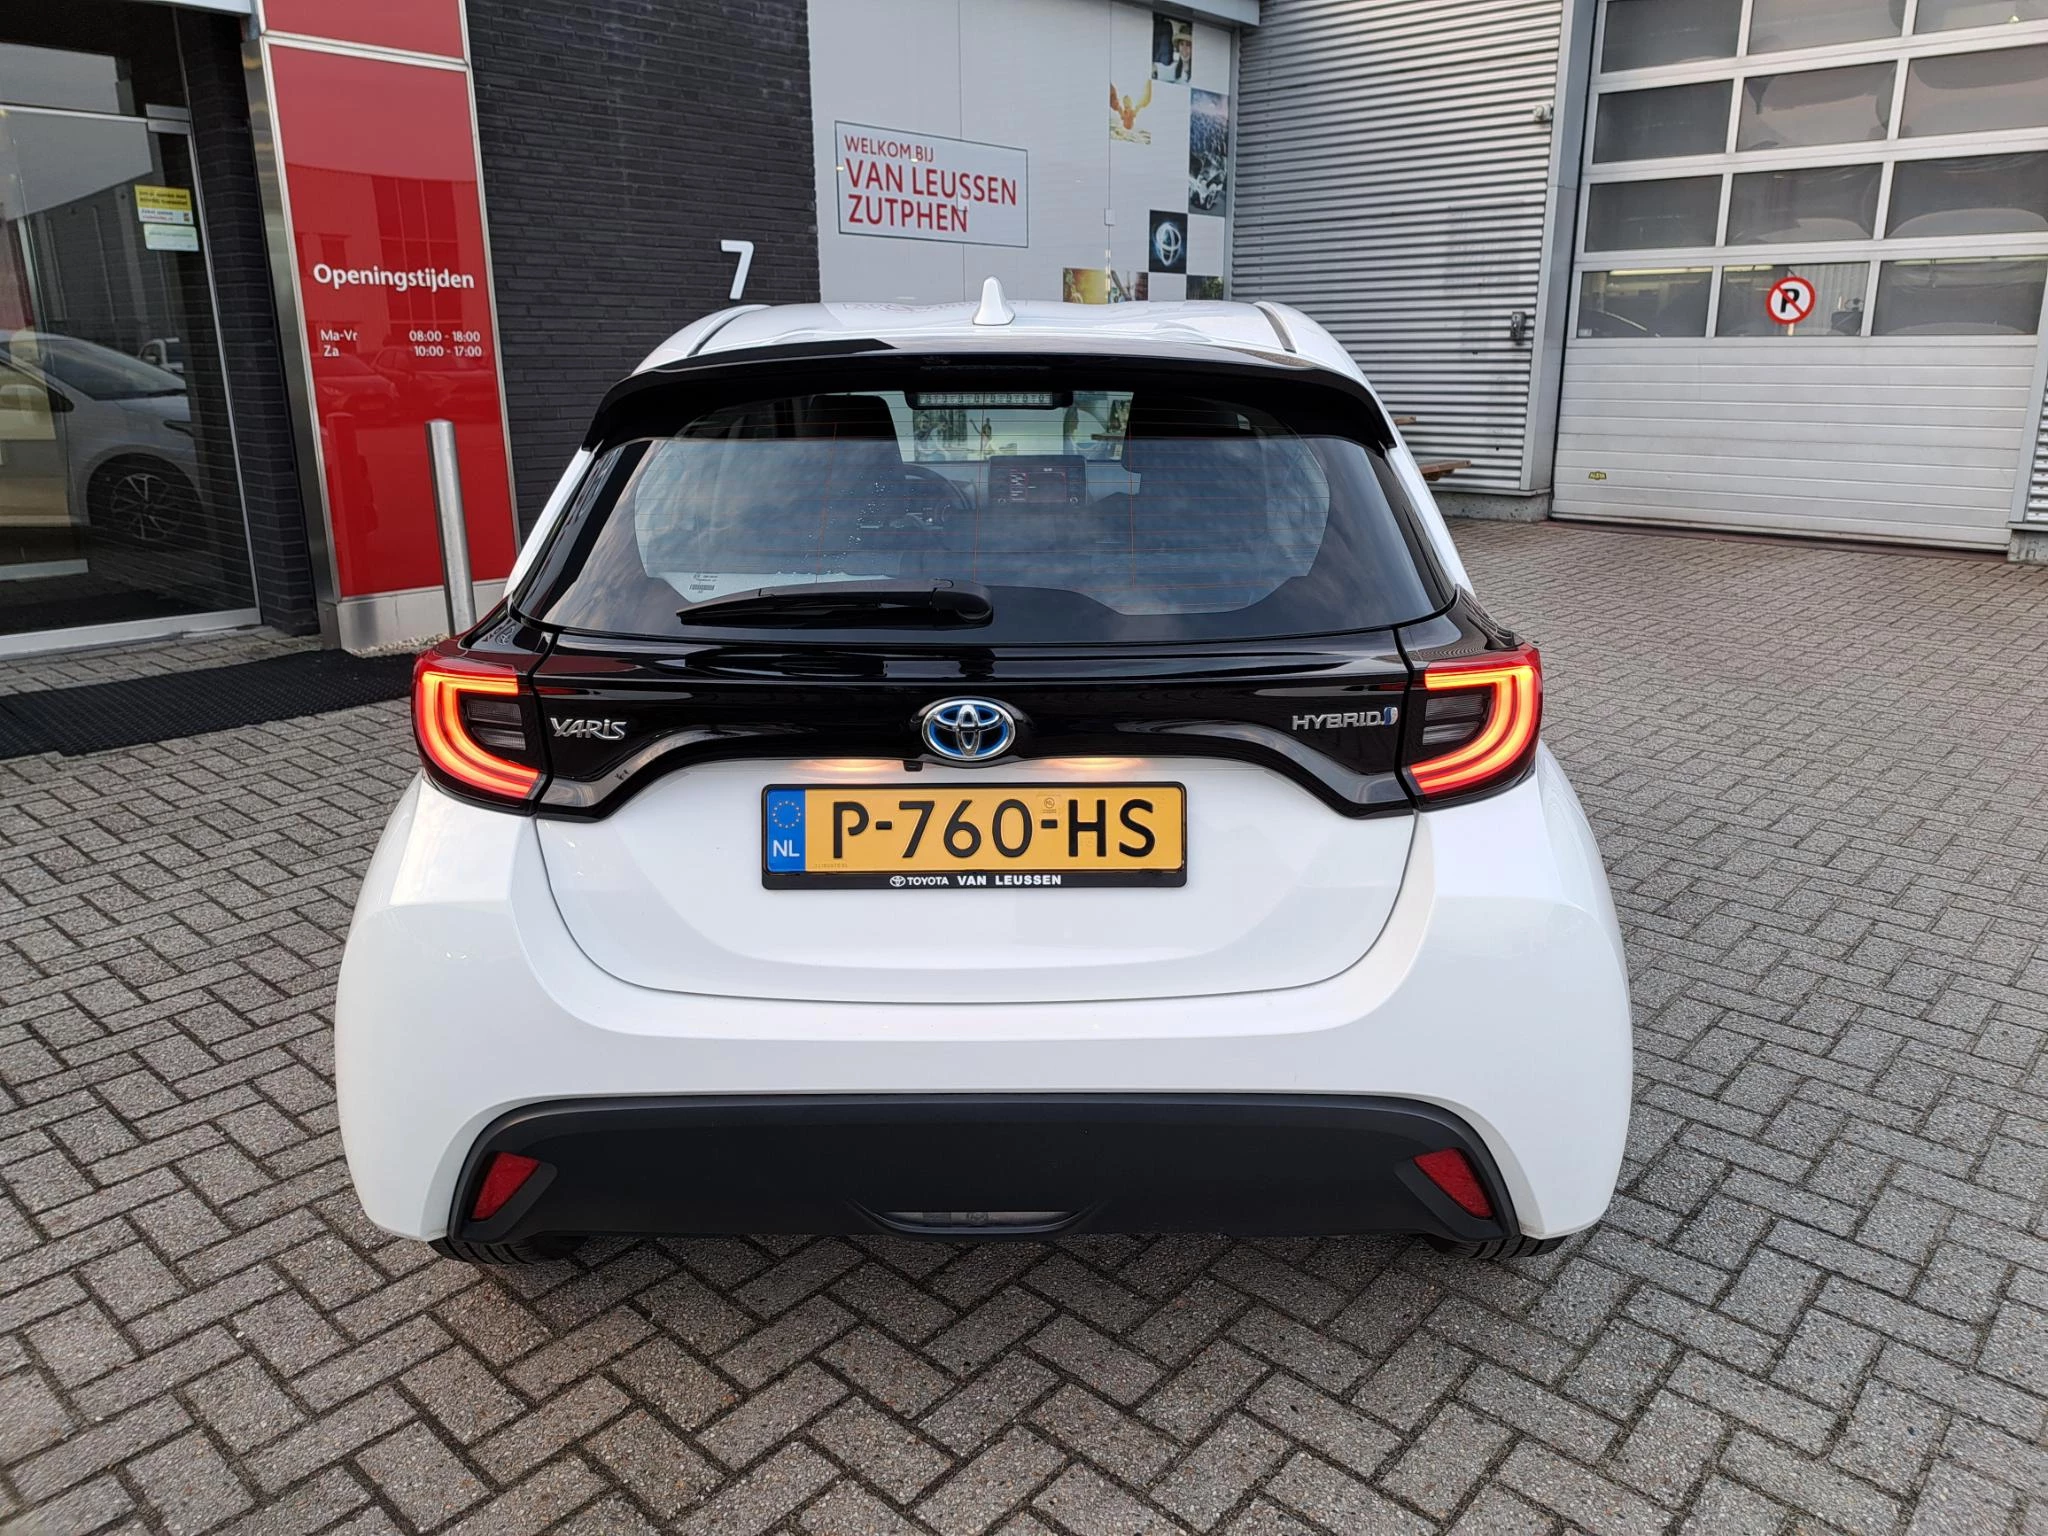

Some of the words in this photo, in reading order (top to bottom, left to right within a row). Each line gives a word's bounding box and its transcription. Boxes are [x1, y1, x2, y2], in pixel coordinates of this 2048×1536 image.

[844, 135, 911, 159] WELKOM
[915, 144, 935, 163] BIJ
[845, 158, 903, 193] VAN
[912, 166, 1017, 206] LEUSSEN
[848, 194, 969, 233] ZUTPHEN
[312, 263, 475, 292] Openingstijden
[720, 239, 755, 300] 7
[320, 329, 359, 342] Ma-Vr
[408, 330, 442, 342] 08:00
[452, 330, 481, 342] 18:00
[323, 345, 340, 357] Za
[414, 345, 444, 357] 10:00
[454, 346, 482, 357] 17:00
[1291, 711, 1381, 730] HYBRID
[832, 799, 1154, 859] P-760-HS
[772, 839, 800, 858] NL
[907, 876, 950, 886] TOYOTA
[956, 875, 987, 886] VAN
[995, 874, 1062, 886] LEUSSEN
